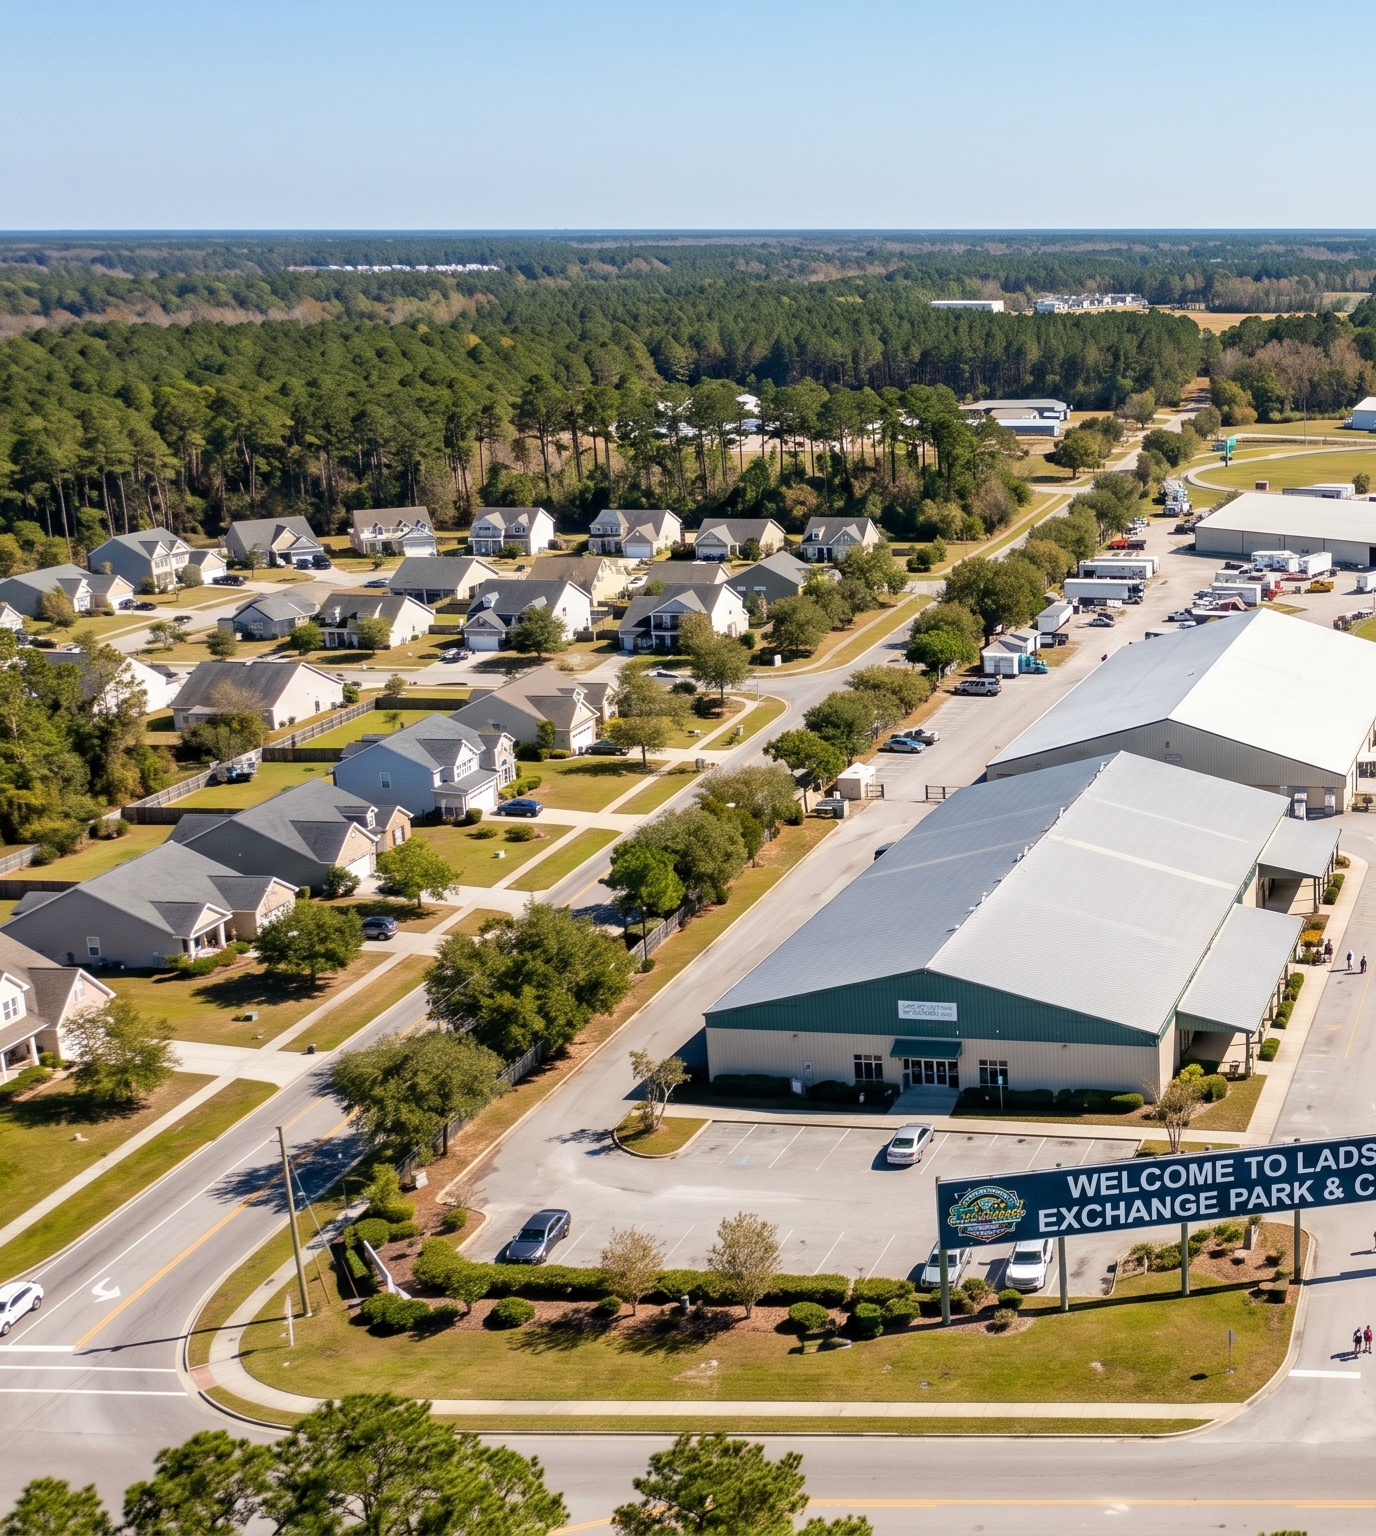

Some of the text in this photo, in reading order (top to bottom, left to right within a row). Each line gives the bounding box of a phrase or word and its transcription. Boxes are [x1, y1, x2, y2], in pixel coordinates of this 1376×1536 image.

[1067, 1160, 1234, 1198] WELCOME
[1245, 1155, 1286, 1179] TO
[1039, 1188, 1219, 1232] EXCHANGE
[1230, 1180, 1314, 1210] PARK
[1323, 1177, 1344, 1200] &
